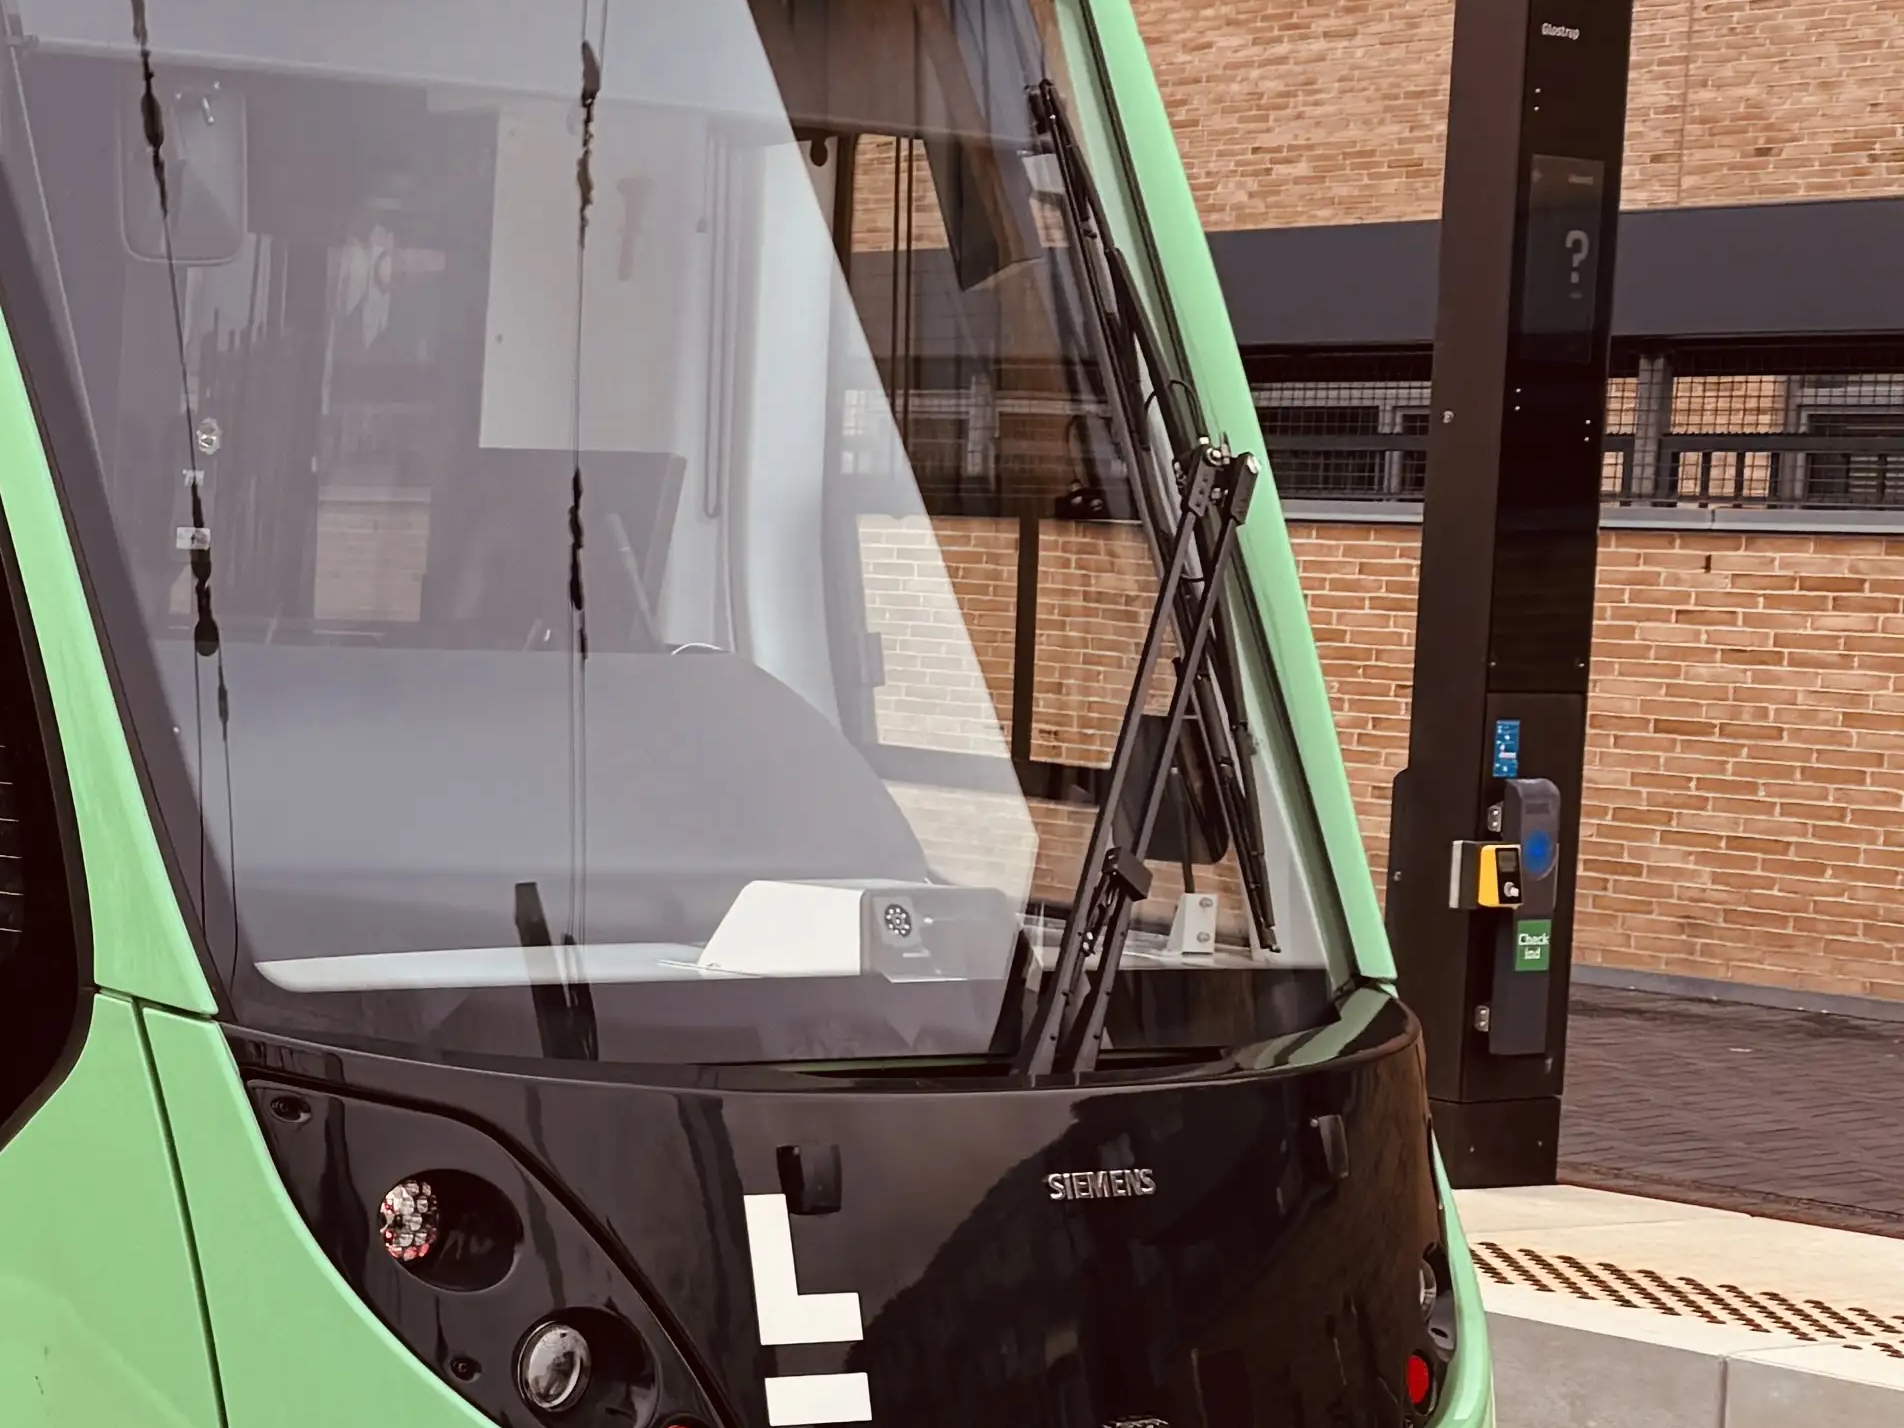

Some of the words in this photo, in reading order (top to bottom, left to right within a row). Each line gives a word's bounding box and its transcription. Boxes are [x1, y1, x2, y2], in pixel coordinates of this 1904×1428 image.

[1541, 22, 1580, 40] Glostrup
[1517, 932, 1550, 946] Check
[1047, 1168, 1157, 1200] SIEMENS
